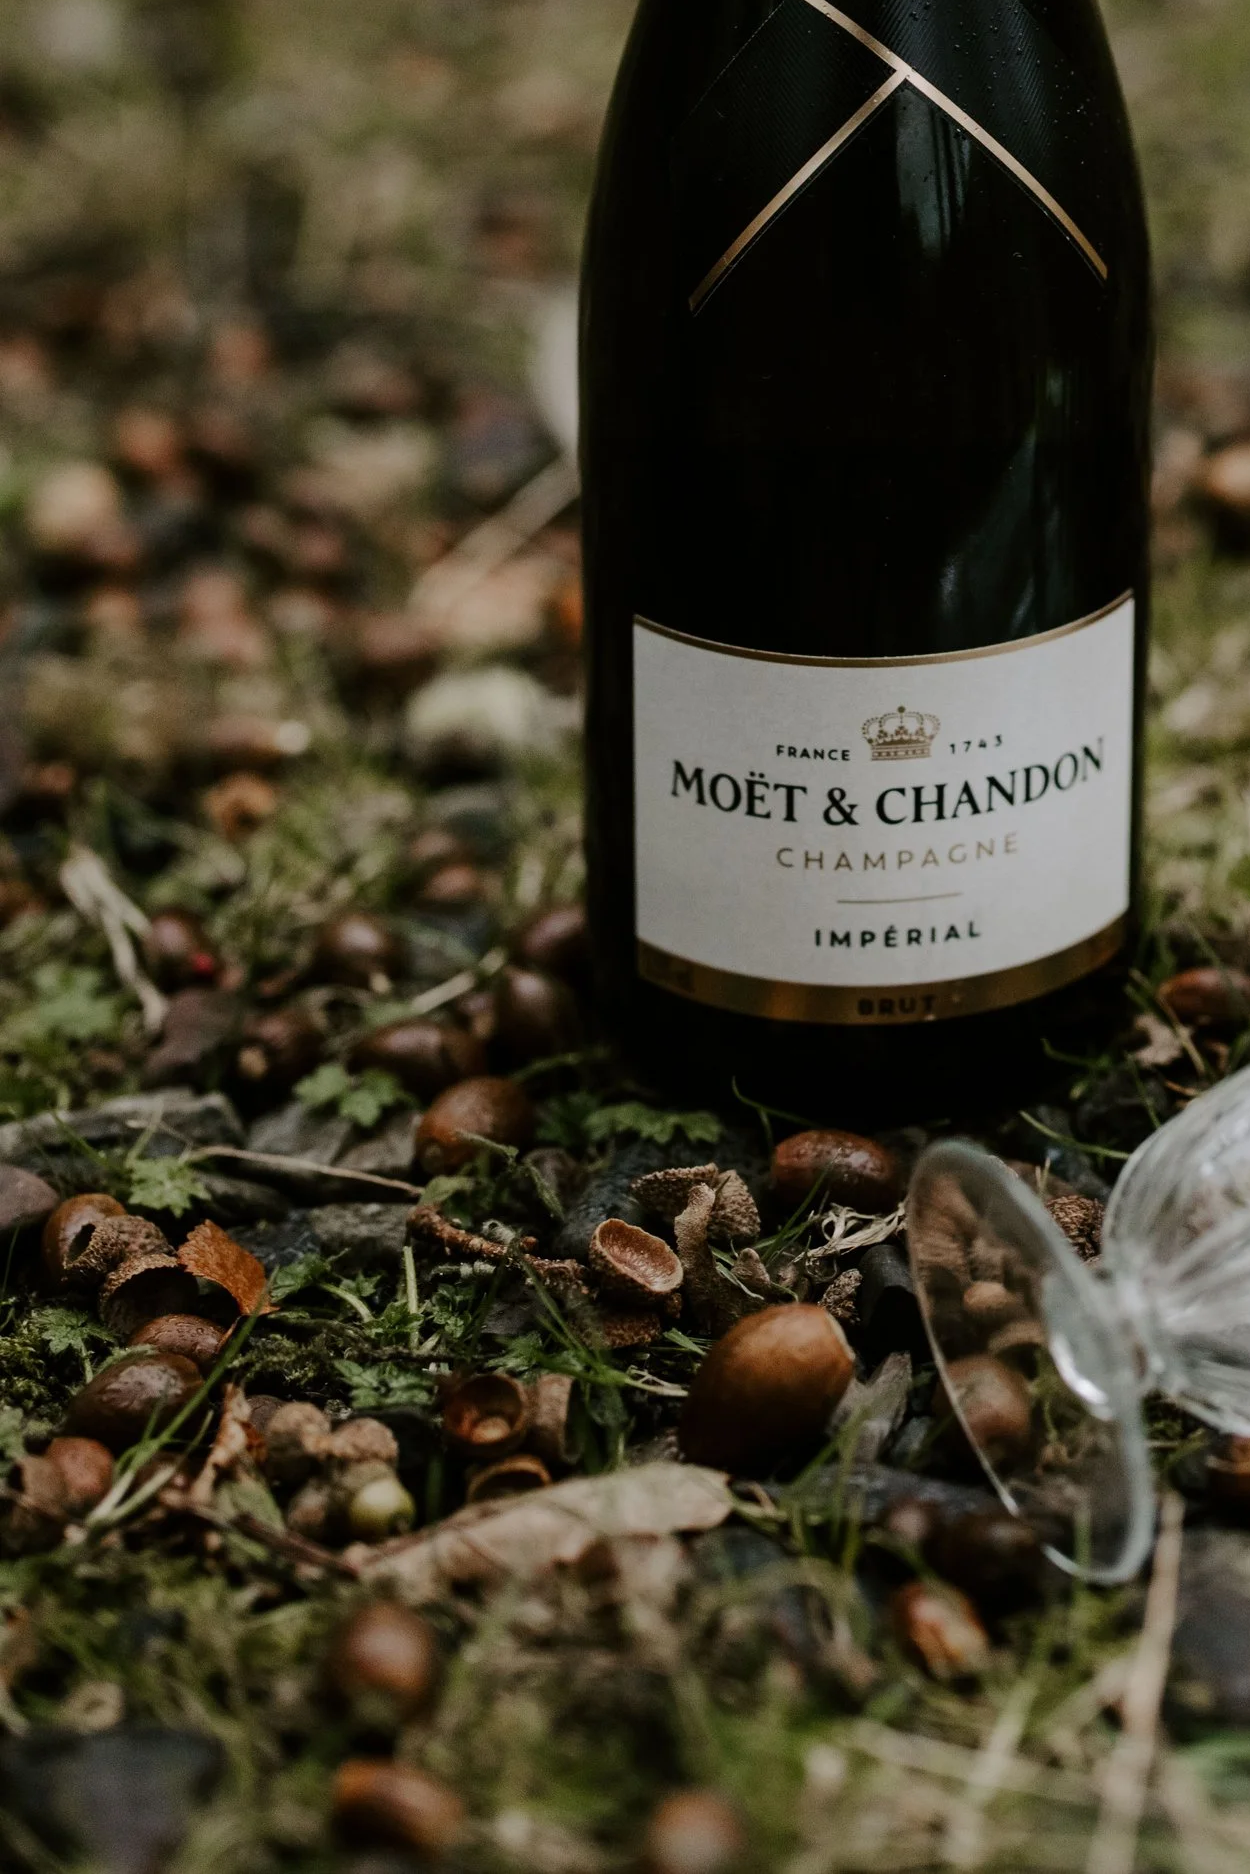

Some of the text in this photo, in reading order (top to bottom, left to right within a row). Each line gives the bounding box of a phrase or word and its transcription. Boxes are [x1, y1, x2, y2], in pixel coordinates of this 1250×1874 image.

[776, 735, 1002, 761] FRANCE 1743
[670, 736, 1104, 826] MOËT & CHANDON
[776, 831, 1019, 872] CHAMPAGNE
[814, 921, 981, 949] IMPÉRIAL
[857, 996, 937, 1017] BRUT
